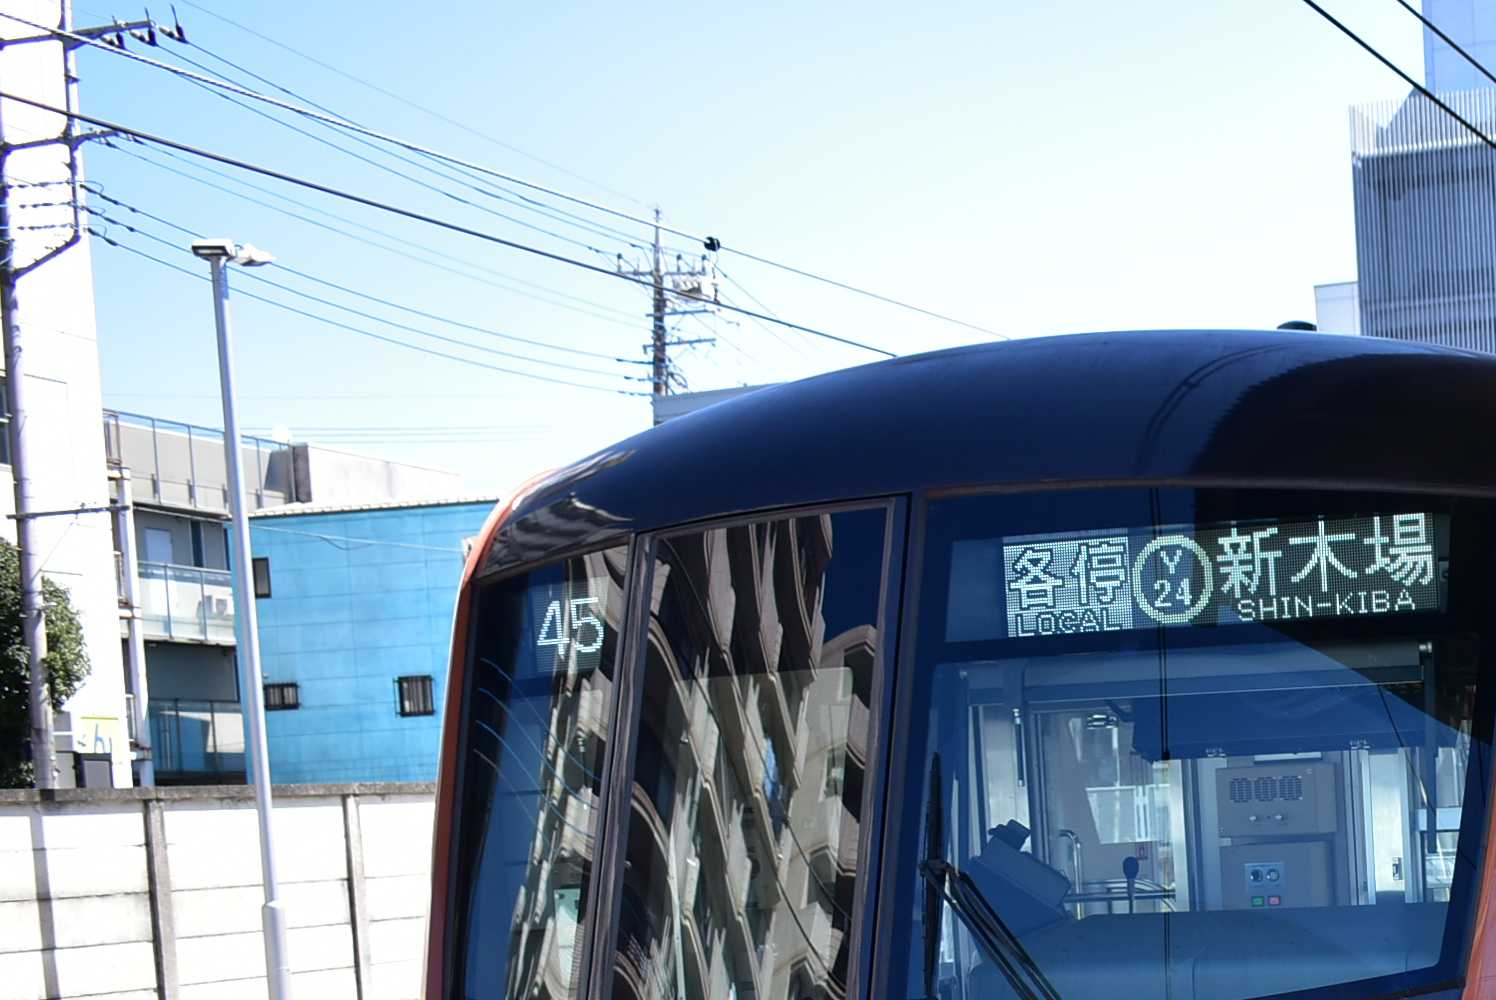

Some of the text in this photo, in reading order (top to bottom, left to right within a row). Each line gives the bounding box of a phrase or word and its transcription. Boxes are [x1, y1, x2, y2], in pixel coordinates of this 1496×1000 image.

[1161, 550, 1182, 574] Y
[1217, 513, 1433, 598] 新木場
[1009, 543, 1126, 609] 各停
[1154, 579, 1192, 607] 24
[1237, 590, 1415, 621] SHIN-KIBA
[537, 597, 604, 655] 45
[1017, 609, 1120, 636] LOCAL
